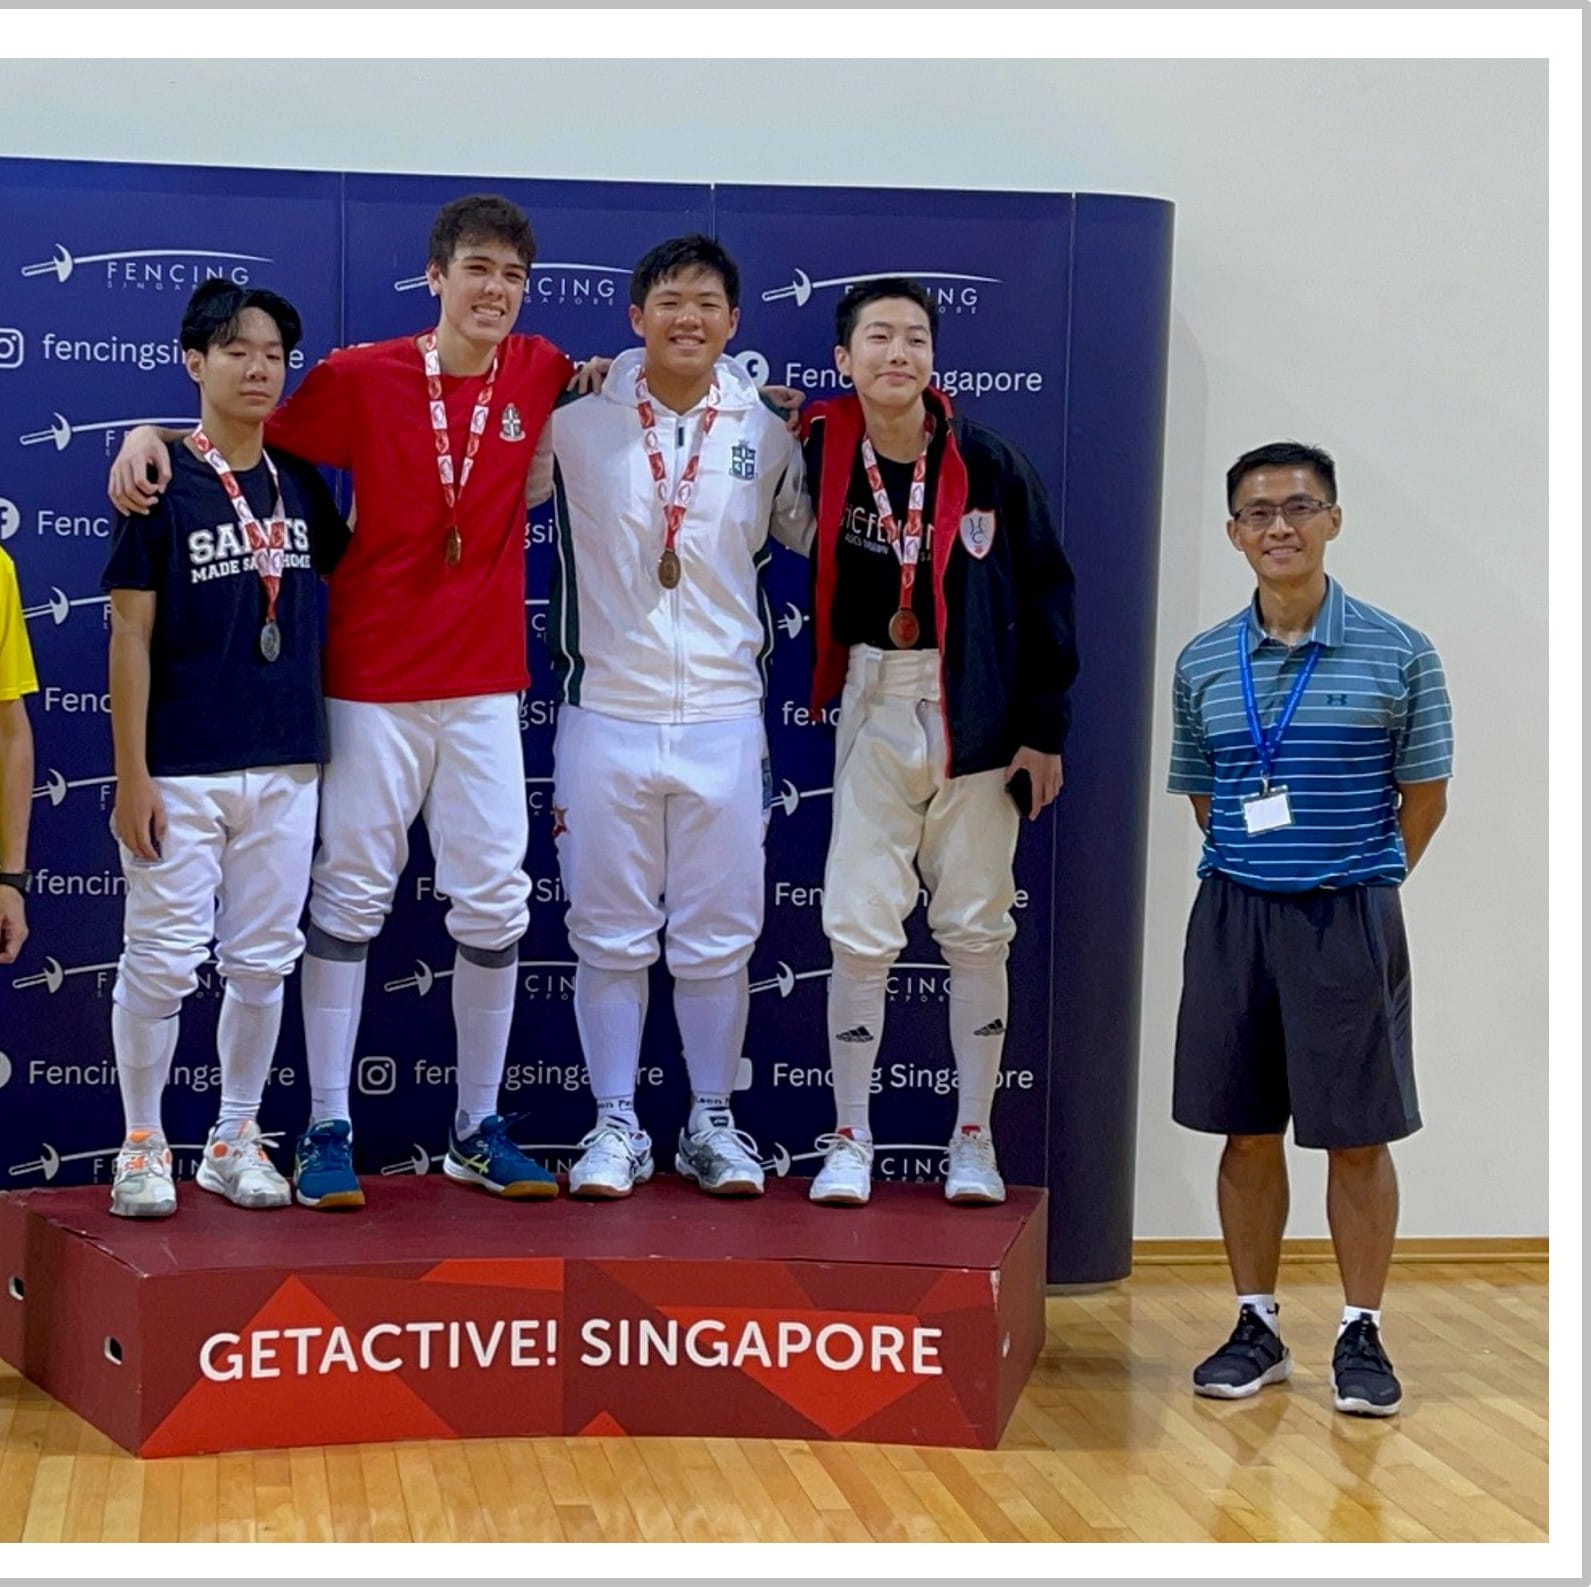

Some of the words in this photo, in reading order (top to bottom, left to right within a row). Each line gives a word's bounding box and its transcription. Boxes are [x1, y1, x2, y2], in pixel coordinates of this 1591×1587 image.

[107, 262, 249, 286] FENCING
[523, 277, 615, 298] CING
[786, 363, 850, 387] Fenc
[932, 370, 1043, 397] ngapore
[38, 511, 110, 538] Fenc
[191, 560, 240, 583] MADE
[45, 687, 111, 713] Fenc
[890, 1063, 1034, 1095] Singaore
[199, 1319, 557, 1381] GETACTIVE!
[580, 1318, 943, 1375] SINGAPORE
